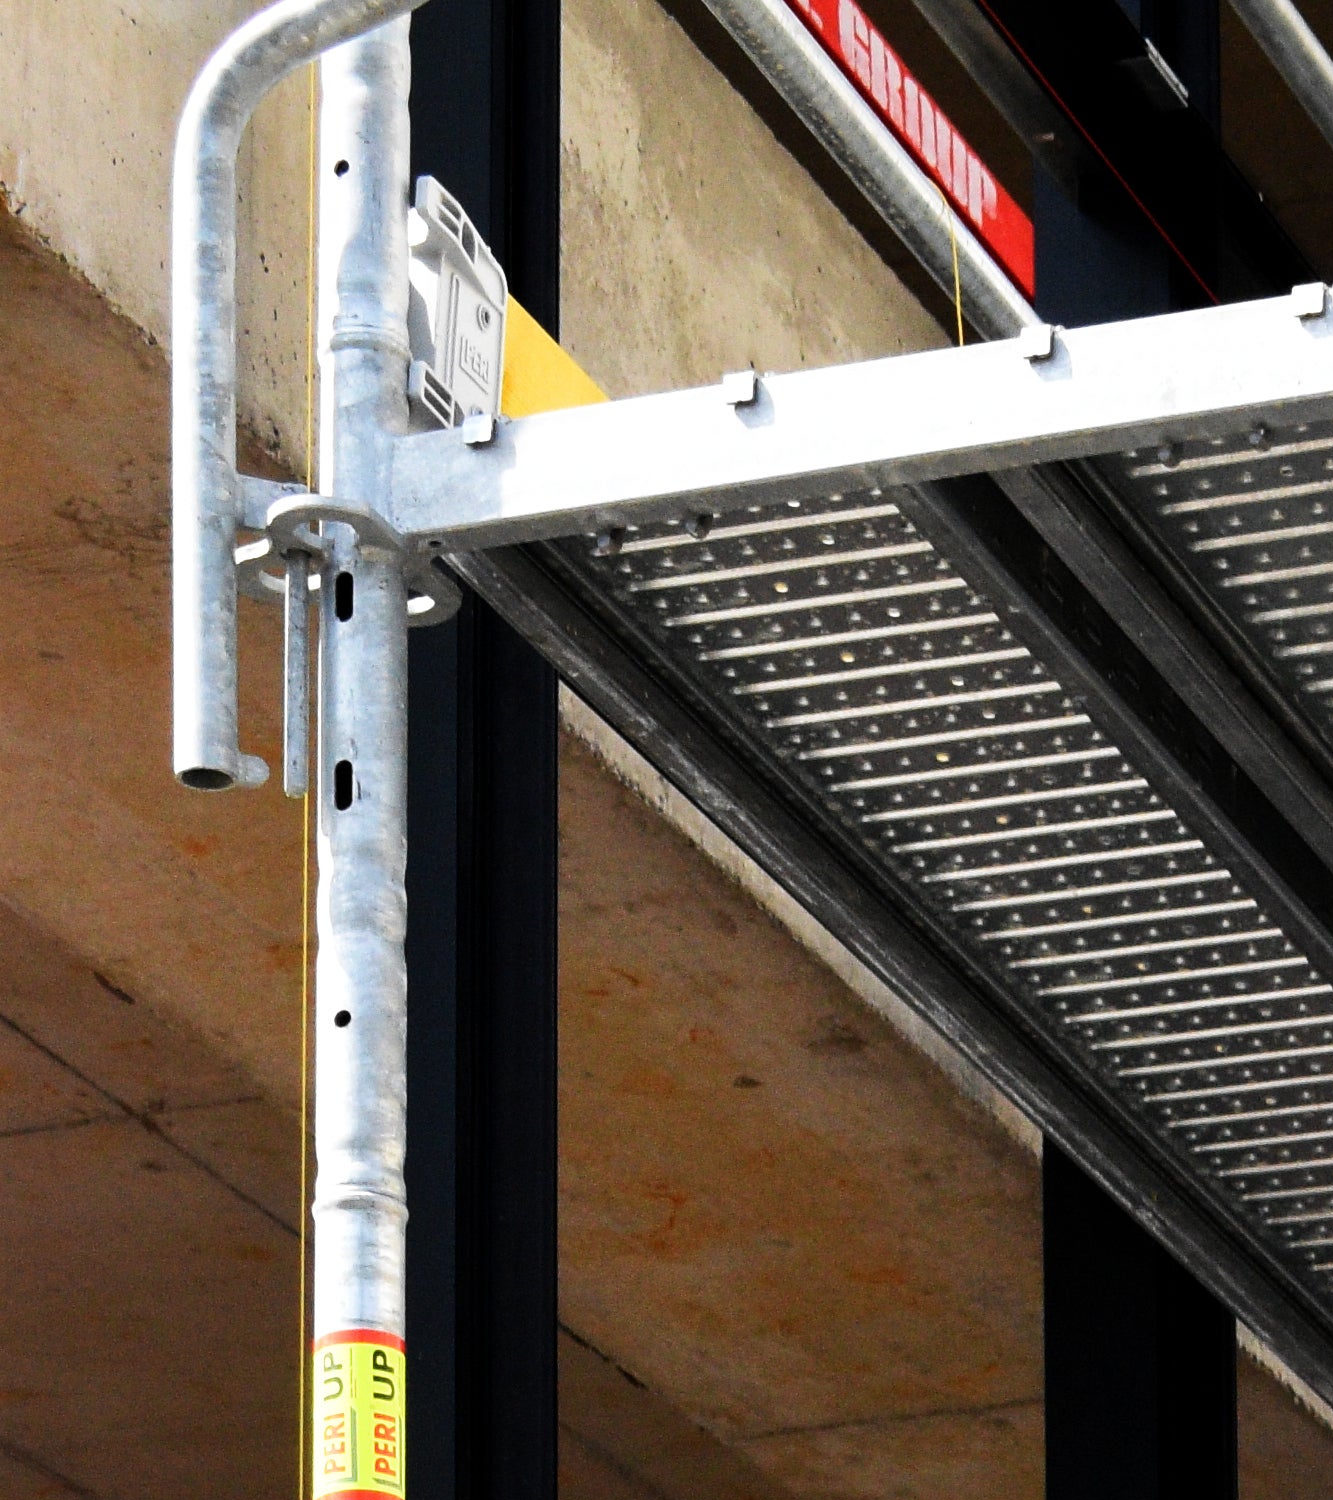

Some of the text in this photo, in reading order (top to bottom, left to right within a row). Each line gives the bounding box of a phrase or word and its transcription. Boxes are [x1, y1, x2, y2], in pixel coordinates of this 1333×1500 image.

[323, 1351, 346, 1475] PERI UP
[372, 1349, 397, 1477] PERI UP
